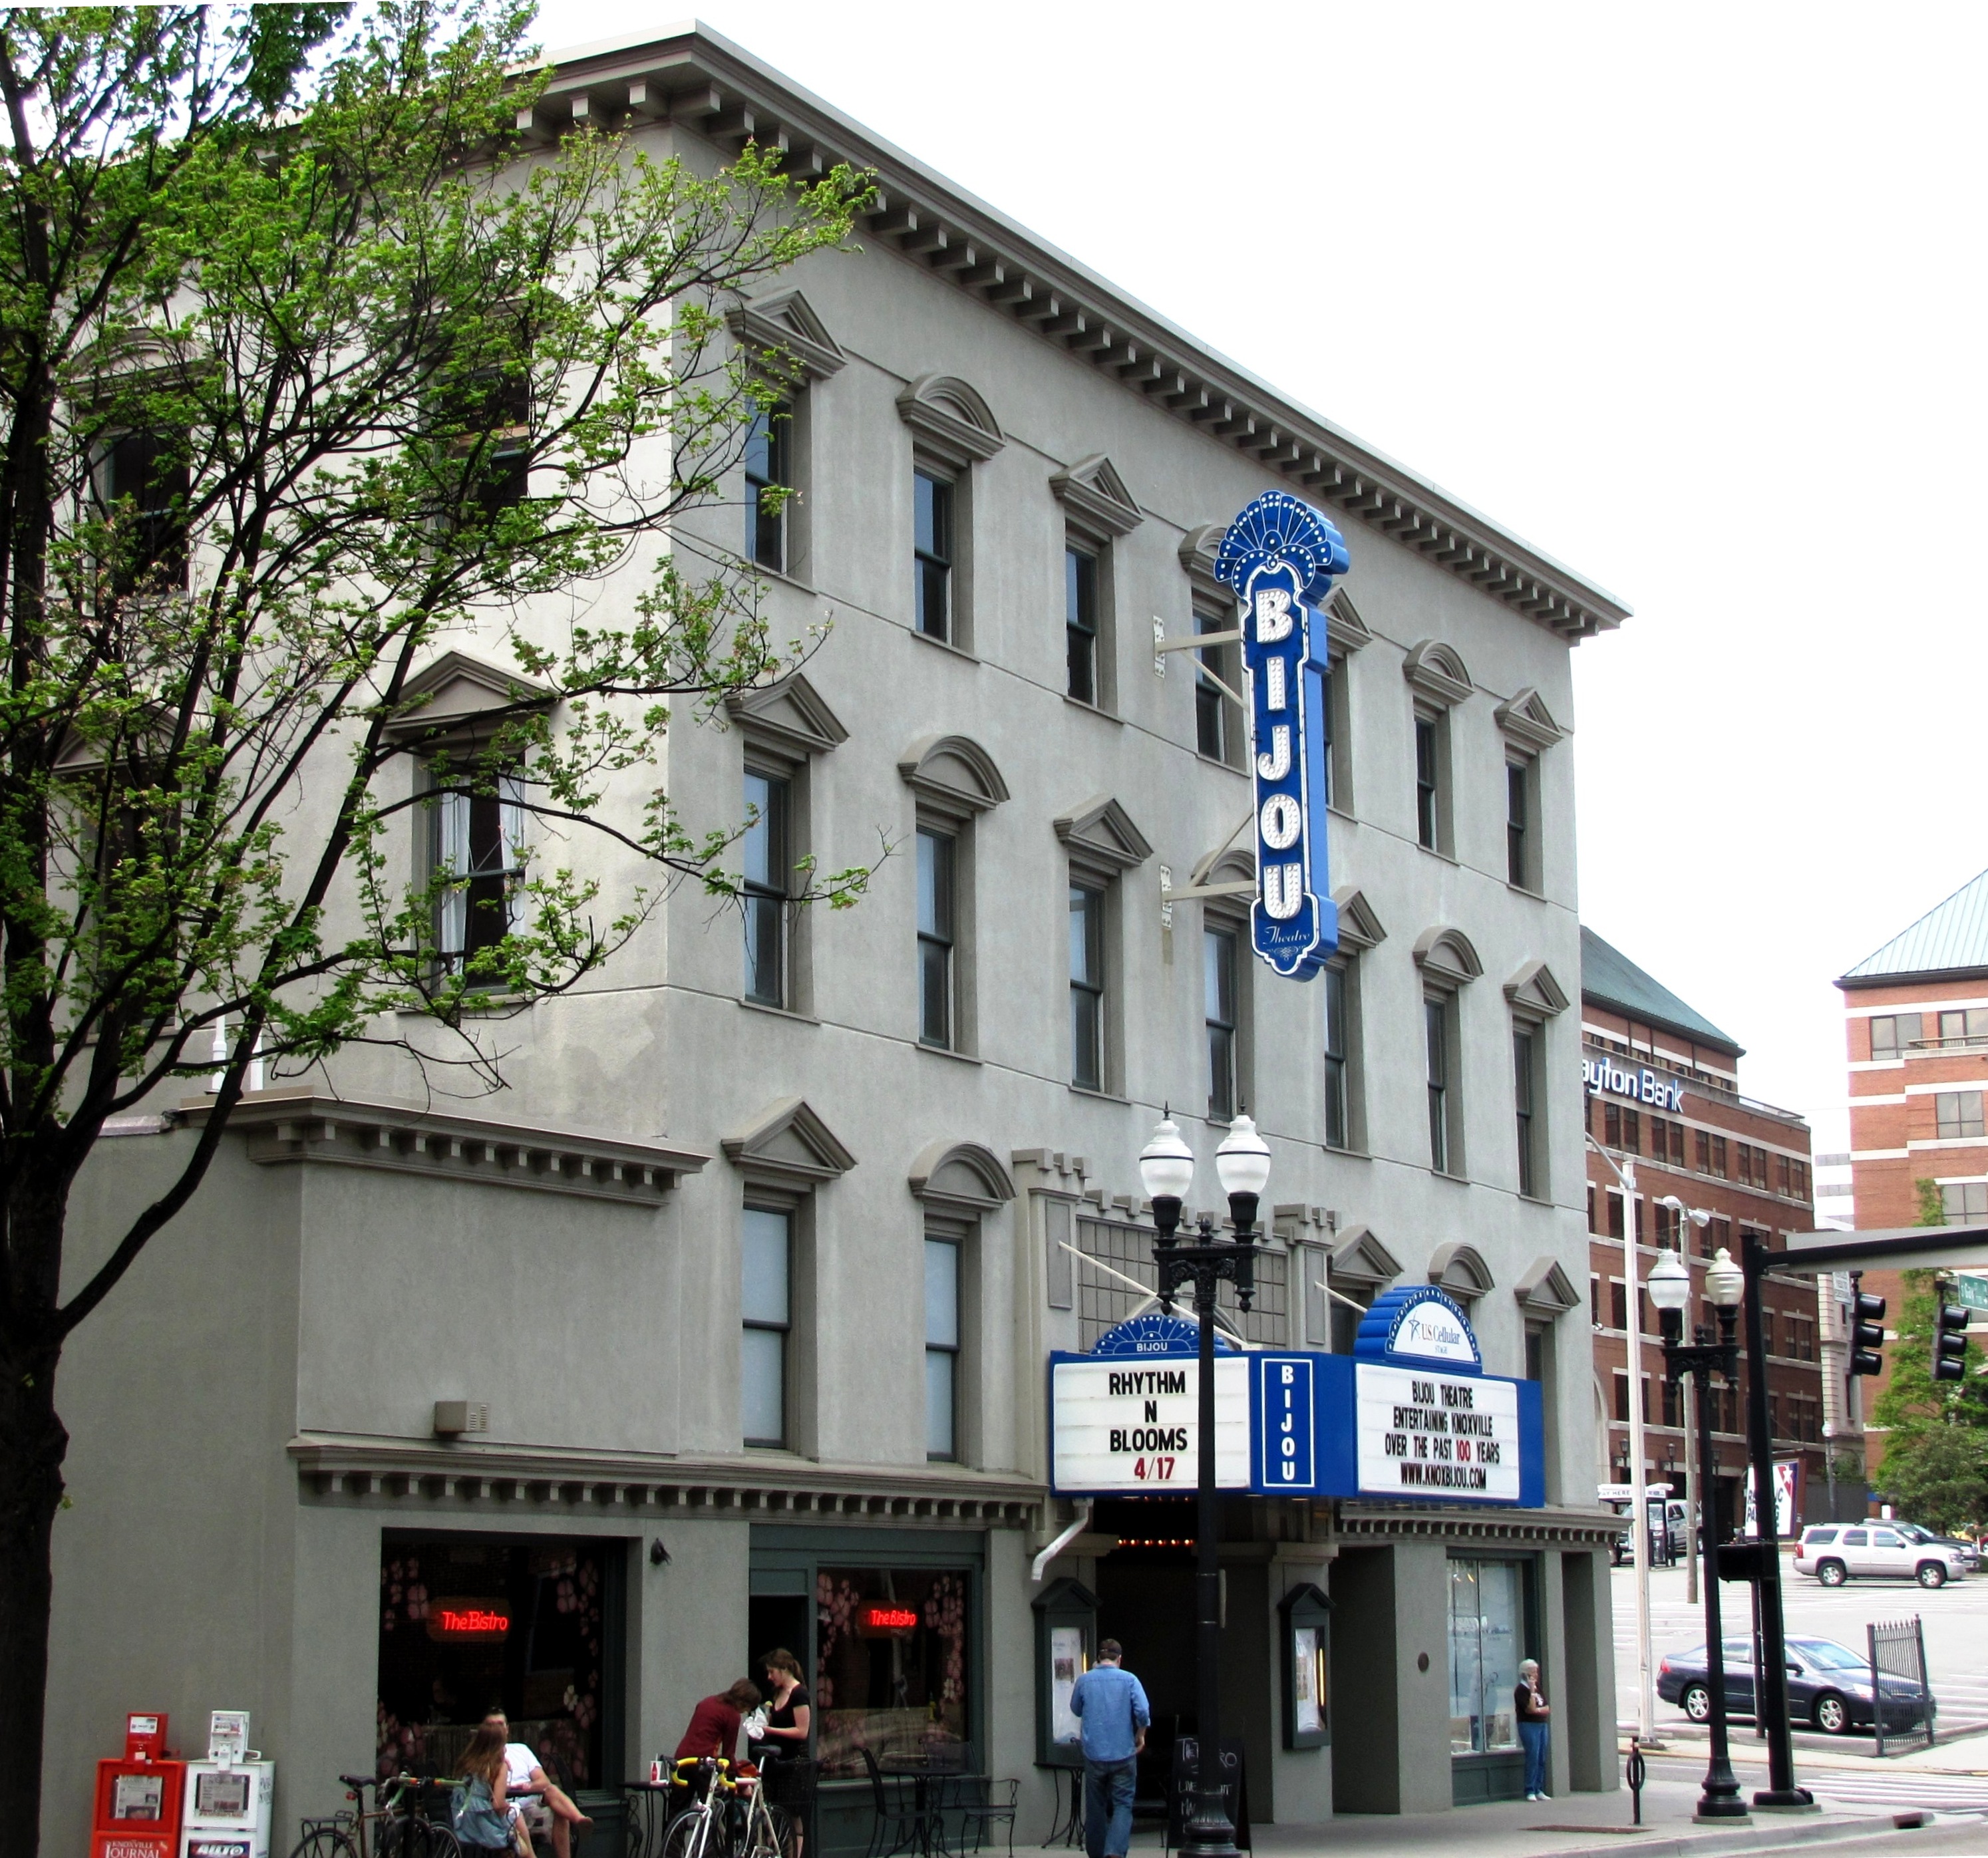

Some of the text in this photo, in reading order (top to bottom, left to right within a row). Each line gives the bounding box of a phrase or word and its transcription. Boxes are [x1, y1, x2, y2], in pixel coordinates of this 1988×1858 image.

[1255, 589, 1303, 920] BIJOU
[1262, 925, 1310, 943] Theatre
[1640, 1069, 1684, 1113] Bank
[1433, 1325, 1460, 1344] Cellular
[1136, 1342, 1168, 1352] BIJOU
[1109, 1371, 1186, 1395] RHYTHM
[1412, 1380, 1473, 1409] BIJOU THEATRE
[1144, 1400, 1158, 1423] N
[1281, 1365, 1295, 1481] BIJOU
[1393, 1406, 1492, 1437] ENTERTAINING KNOXVILLE
[1110, 1428, 1188, 1452] BLOOMS
[1385, 1433, 1500, 1464] OVER THE PAST 100 YEARS
[1134, 1457, 1175, 1479] 4/17
[1401, 1462, 1486, 1489] WWW.KNOXBIJOU.COM
[442, 1611, 508, 1630] The Bistro
[871, 1609, 916, 1626] The Bistro
[111, 1840, 154, 1849] KNOXVILLE
[196, 1843, 245, 1856] AUTO
